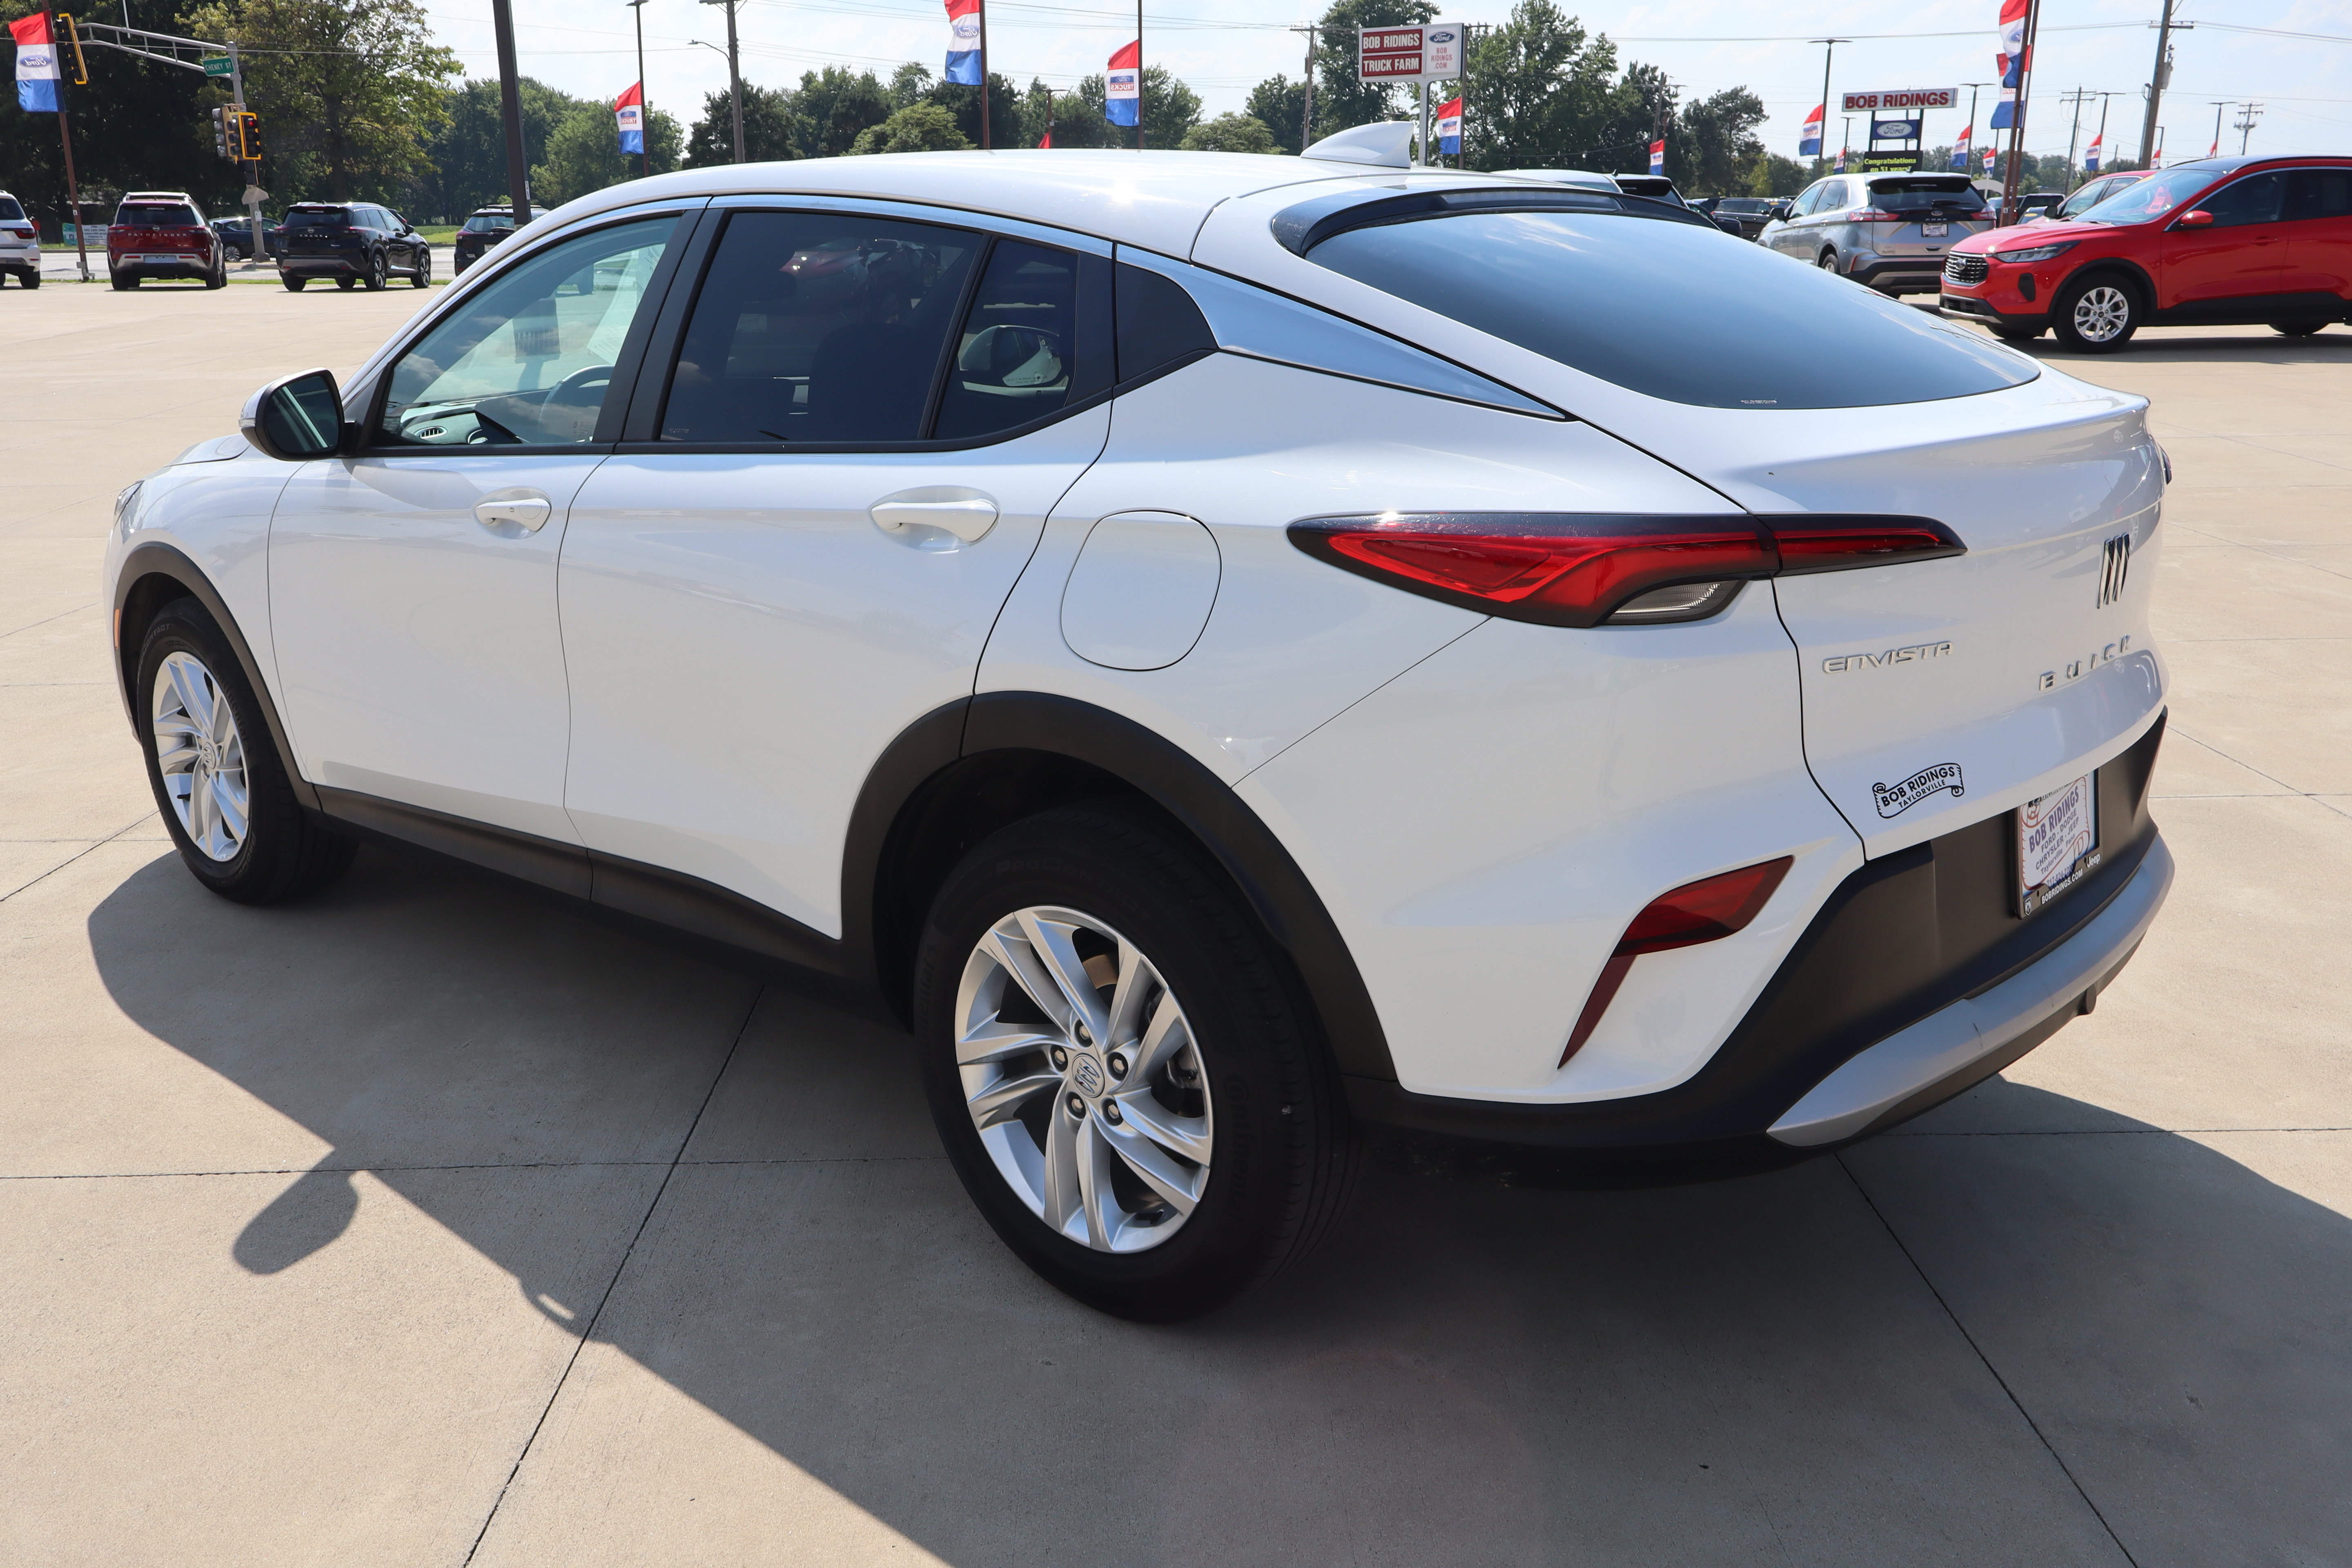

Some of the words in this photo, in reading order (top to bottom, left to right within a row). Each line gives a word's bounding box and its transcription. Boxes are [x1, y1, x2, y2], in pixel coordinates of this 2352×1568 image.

[1363, 36, 1381, 49] BOB
[1383, 33, 1420, 48] RIDINGS
[1434, 33, 1450, 42] Ford
[205, 63, 223, 71] CHENEY
[1363, 59, 1392, 72] TRUCK
[1394, 58, 1419, 71] FARM
[1845, 95, 1878, 109] BOB
[1883, 91, 1949, 107] RIDINGS
[1884, 125, 1906, 134] Ford
[1822, 640, 1954, 674] ENVISTA
[2039, 634, 2132, 691] BUICK
[1881, 786, 1907, 807] BOB
[1907, 766, 1955, 792] RIDINGS
[1898, 779, 1946, 808] TAYLORVILLE
[2029, 822, 2047, 854] BOB
[2048, 786, 2079, 833] RIDINGS
[2041, 833, 2056, 853] FORD
[2060, 807, 2077, 833] DODGE
[2036, 834, 2064, 871] CHRYSLER
[2067, 816, 2079, 836] JEEP
[2041, 847, 2063, 875] Taylorville
[2065, 834, 2076, 848] Pana
[2087, 853, 2100, 868] Jeep
[2041, 868, 2083, 904] BOBRIDINGS.COM
